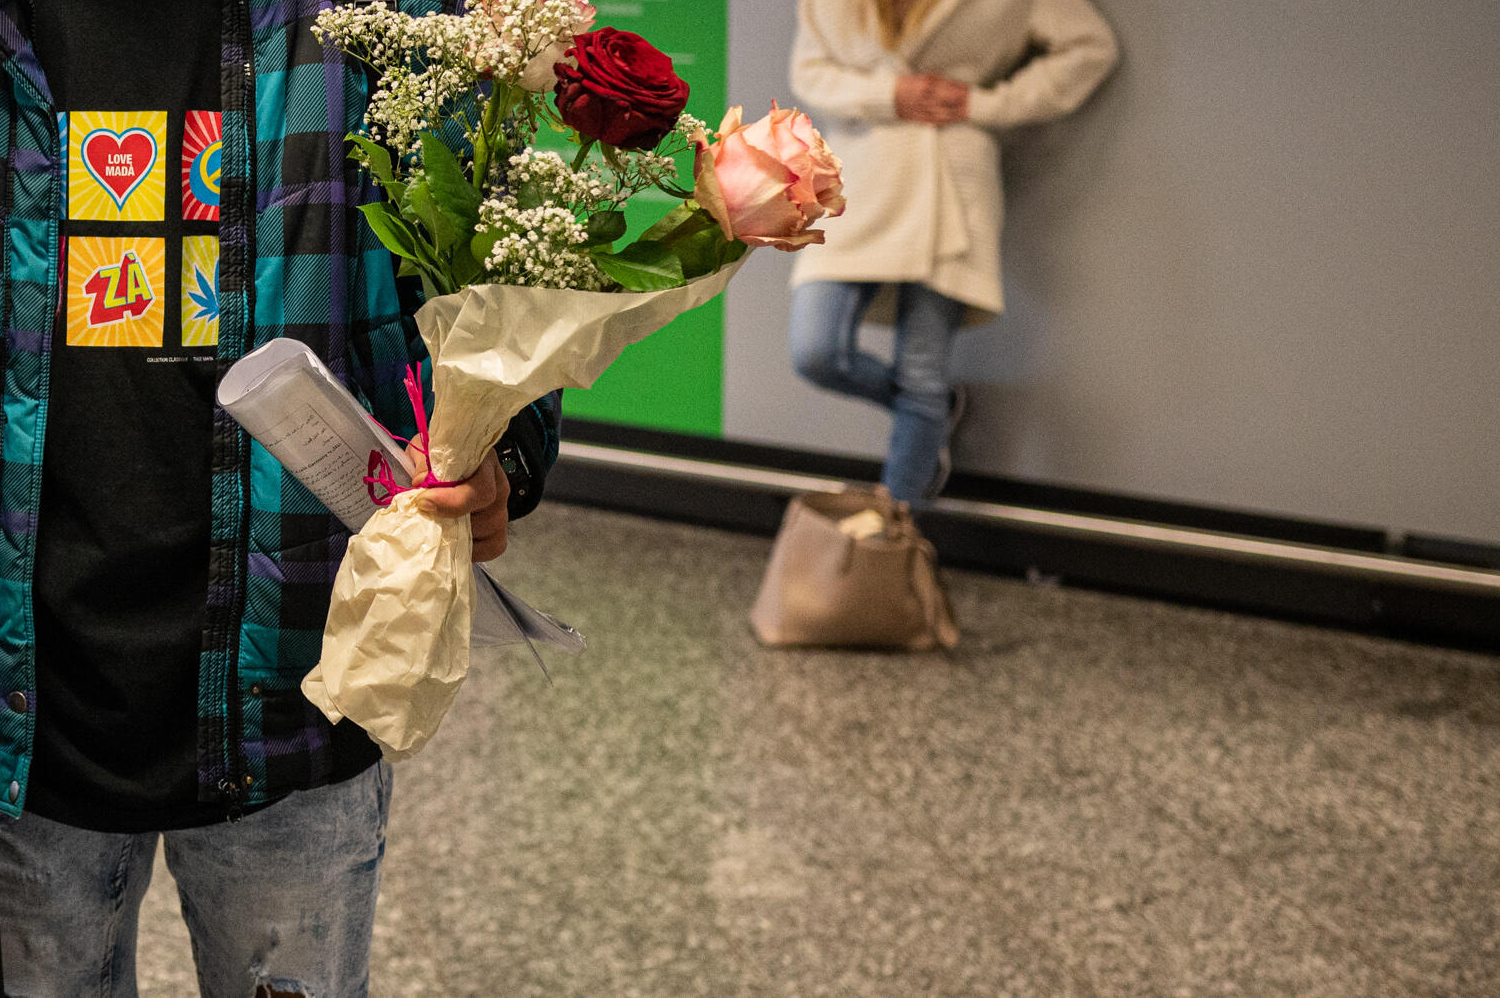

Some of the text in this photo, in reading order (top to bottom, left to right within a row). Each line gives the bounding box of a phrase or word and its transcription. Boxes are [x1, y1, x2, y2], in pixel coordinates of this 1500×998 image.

[107, 153, 133, 165] LOVE
[105, 163, 136, 177] MADÀ
[97, 251, 154, 310] ZÀ
